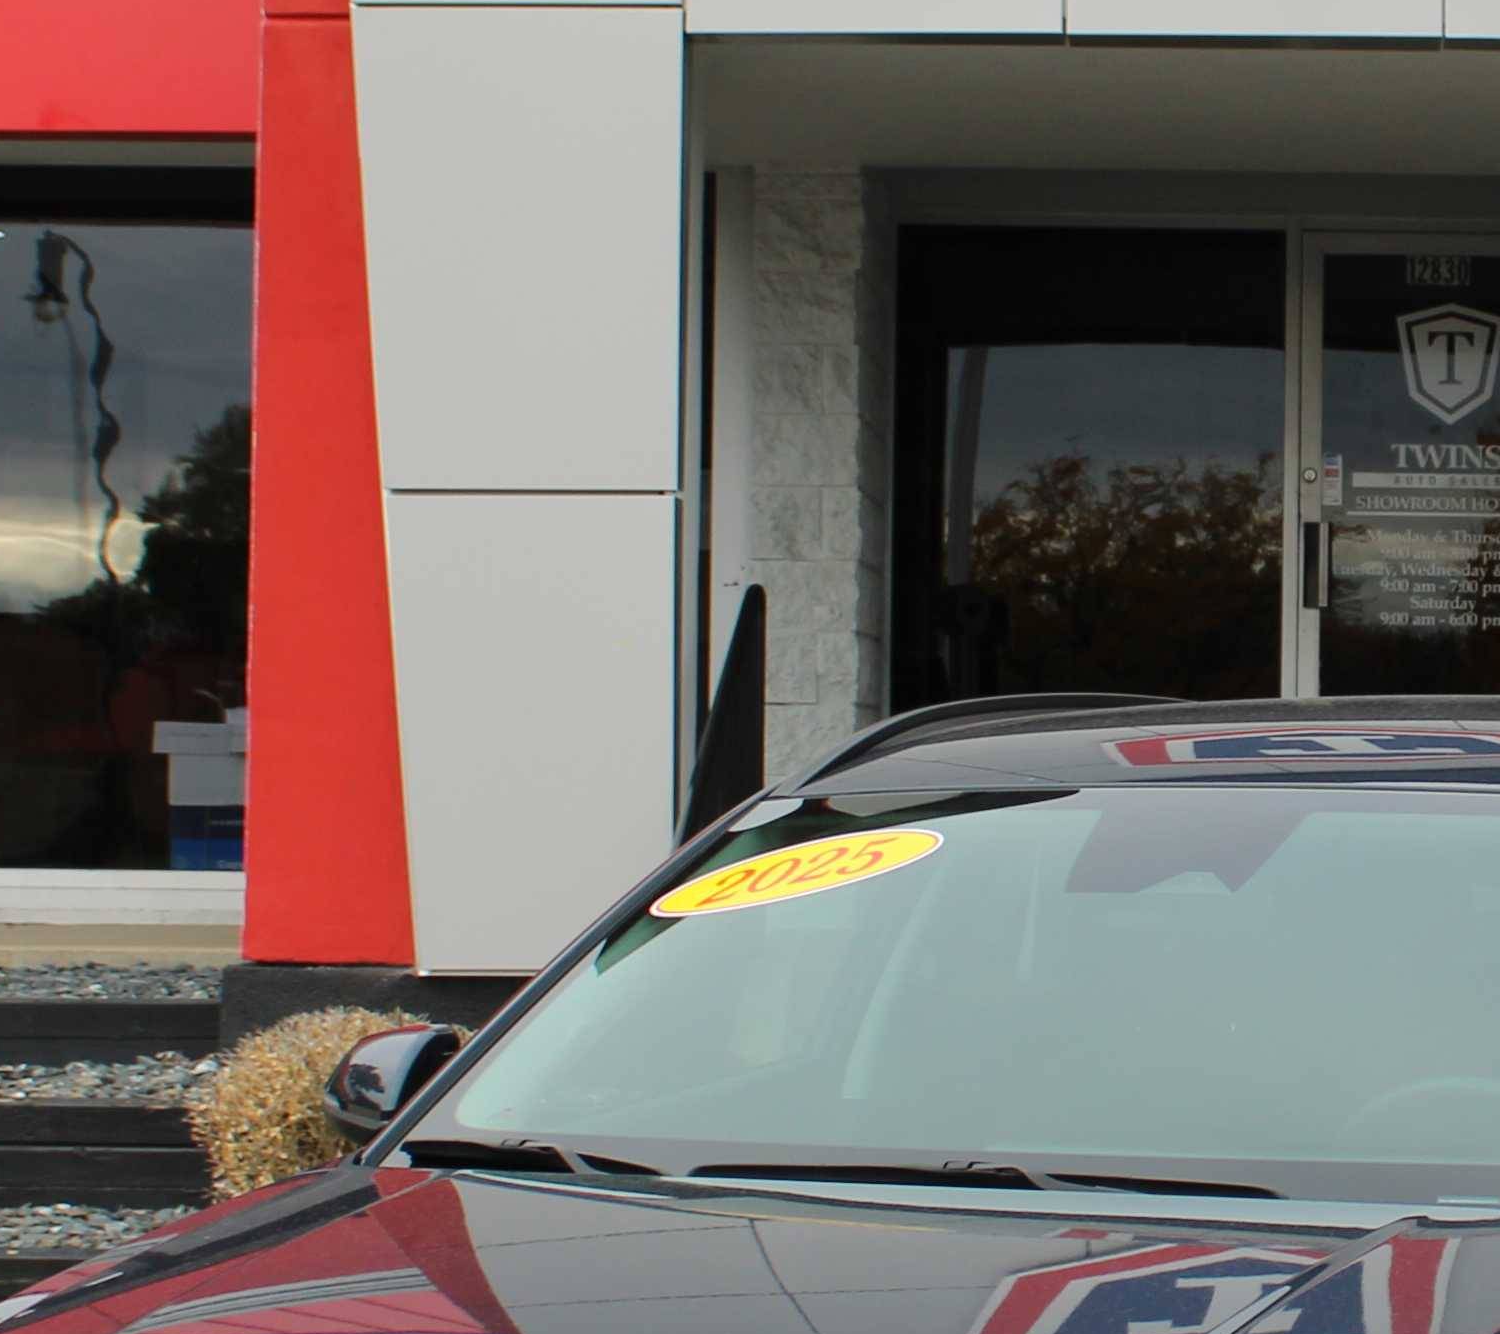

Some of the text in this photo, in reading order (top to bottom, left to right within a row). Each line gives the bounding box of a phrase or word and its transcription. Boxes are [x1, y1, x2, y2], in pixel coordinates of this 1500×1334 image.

[1428, 331, 1475, 385] T
[1355, 495, 1467, 510] SHOWROOM
[1401, 562, 1486, 581] Wednesday
[1380, 578, 1409, 593] 9:00
[1412, 581, 1436, 593] am
[1449, 579, 1478, 593] 7:00
[1409, 595, 1477, 613] Saturday
[1380, 611, 1409, 626] 9:00
[1412, 615, 1435, 626] am
[1449, 612, 1478, 626] 6:00
[694, 835, 900, 908] 2025
